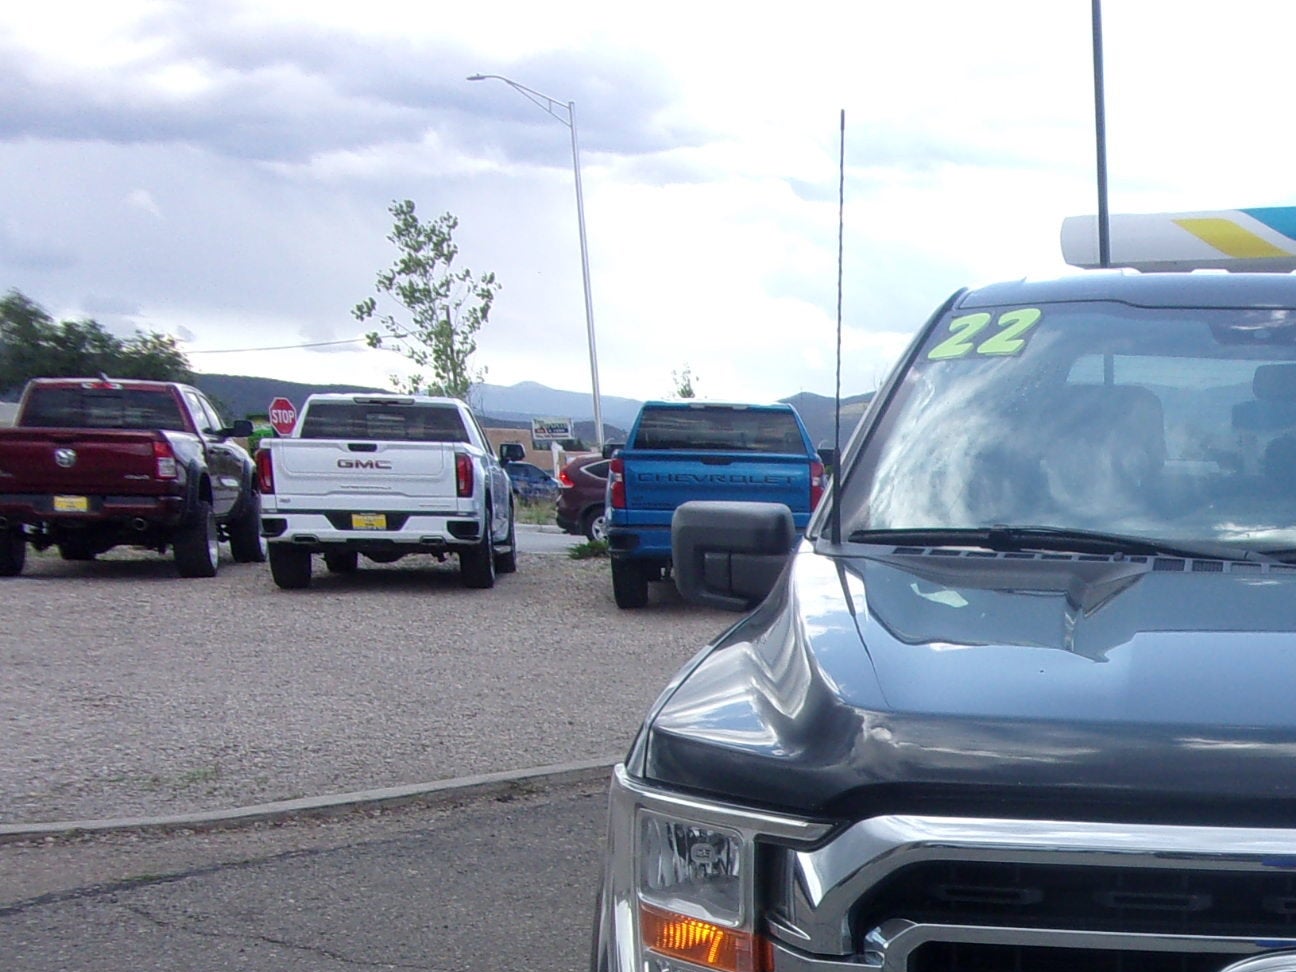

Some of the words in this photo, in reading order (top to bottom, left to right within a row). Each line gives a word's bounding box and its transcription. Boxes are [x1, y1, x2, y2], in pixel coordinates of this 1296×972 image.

[928, 308, 1041, 360] 22
[271, 409, 295, 424] STOP
[337, 459, 392, 469] GMC
[638, 473, 797, 485] CHEVROLET
